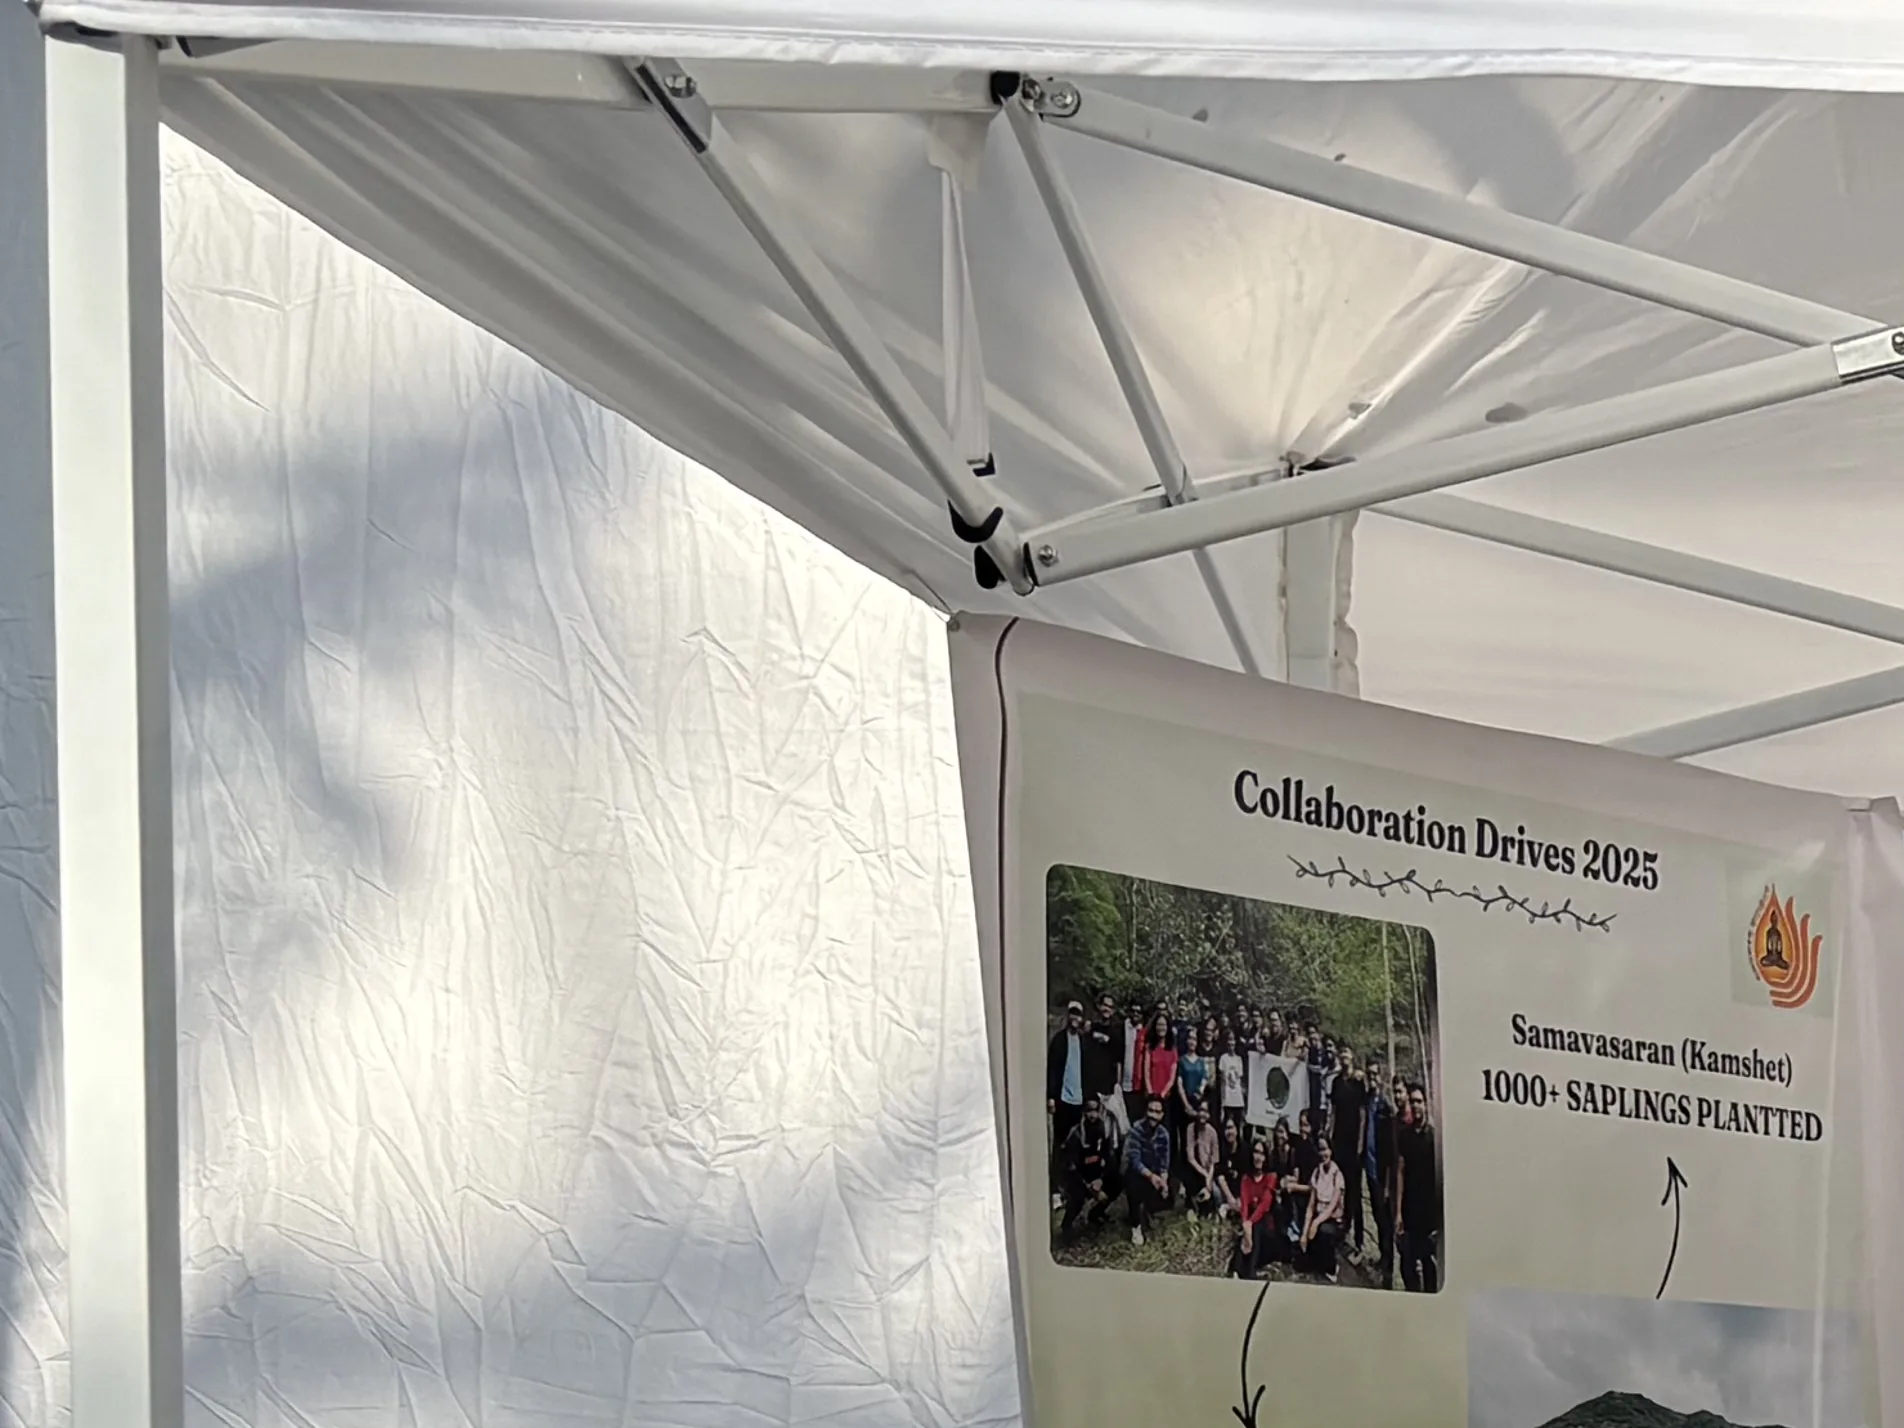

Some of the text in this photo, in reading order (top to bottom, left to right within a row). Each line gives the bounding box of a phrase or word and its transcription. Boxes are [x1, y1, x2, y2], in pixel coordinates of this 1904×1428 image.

[1234, 770, 1659, 890] Collaboration Drives 2025
[1511, 1013, 1793, 1088] Samavasaran (Kamshet)
[1482, 1069, 1823, 1142] 1000+ SAPLINGS PLANTTED
